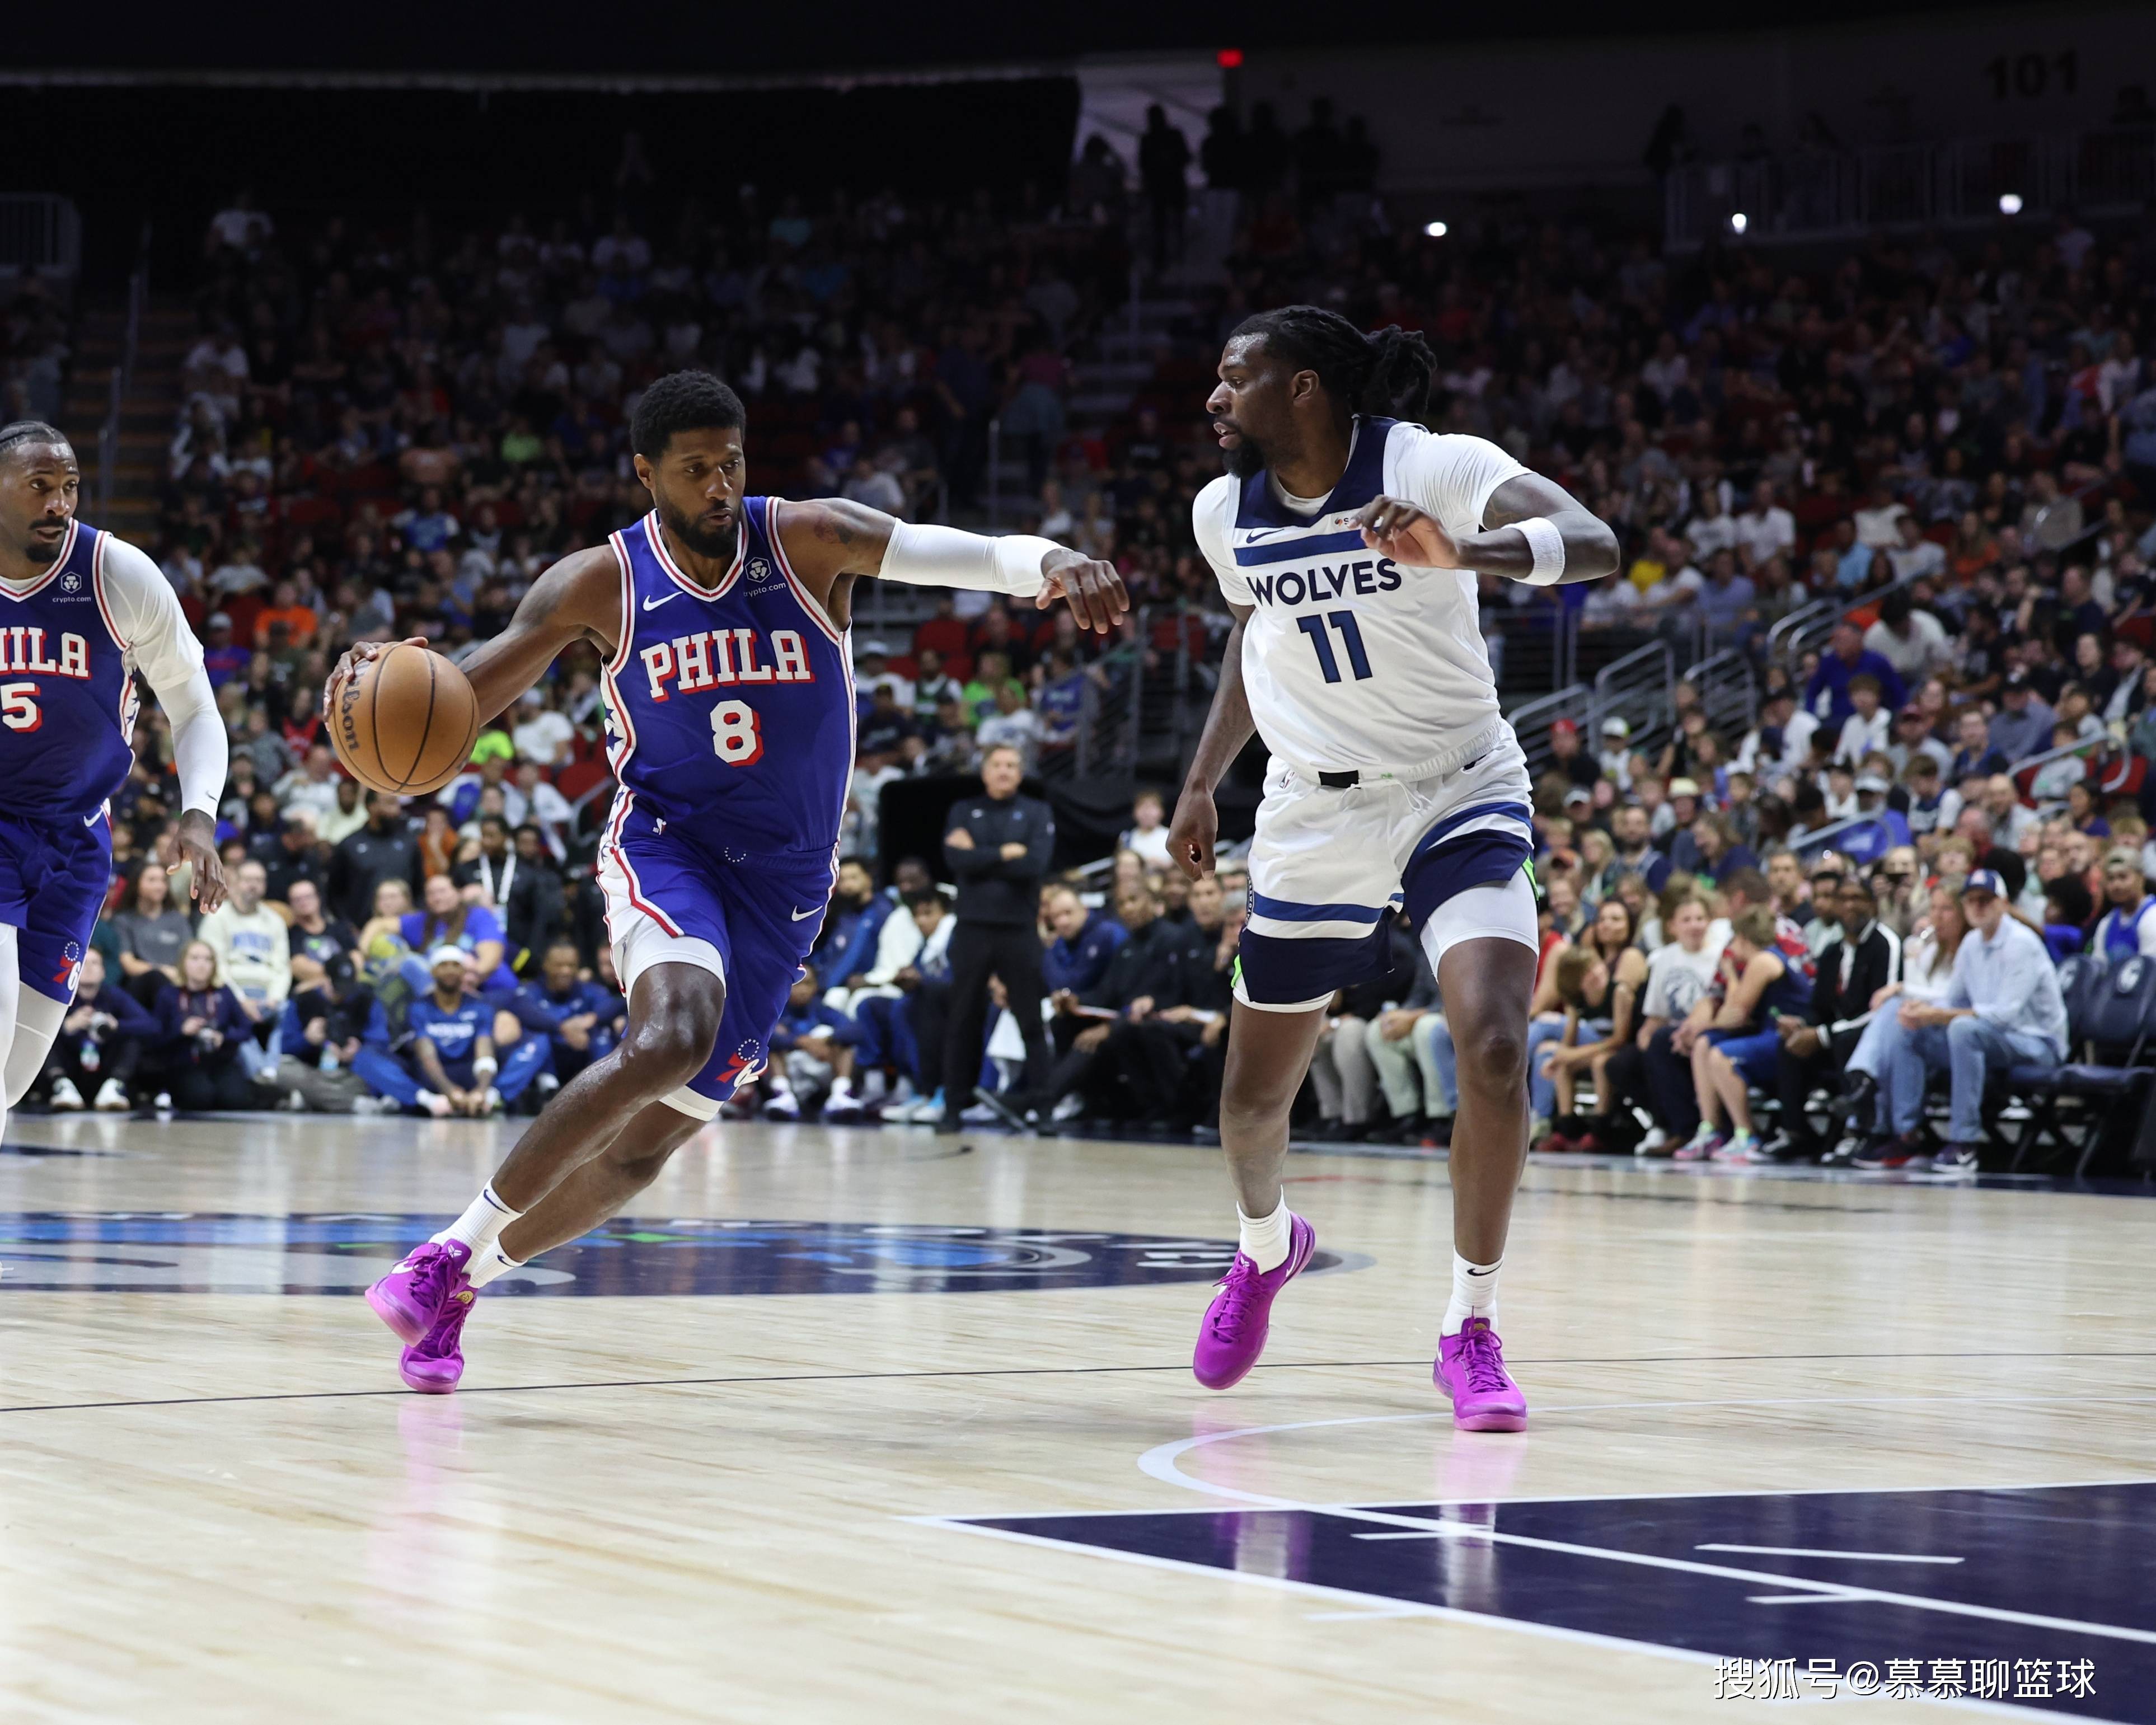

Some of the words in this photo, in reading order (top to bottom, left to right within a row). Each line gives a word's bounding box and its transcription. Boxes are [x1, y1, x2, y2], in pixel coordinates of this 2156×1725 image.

[1982, 48, 2077, 101] 101
[1246, 559, 1402, 607] WOLVES
[640, 628, 815, 703] PHILA
[1296, 610, 1373, 683] 11
[1, 682, 43, 733] 5
[710, 700, 764, 767] 8
